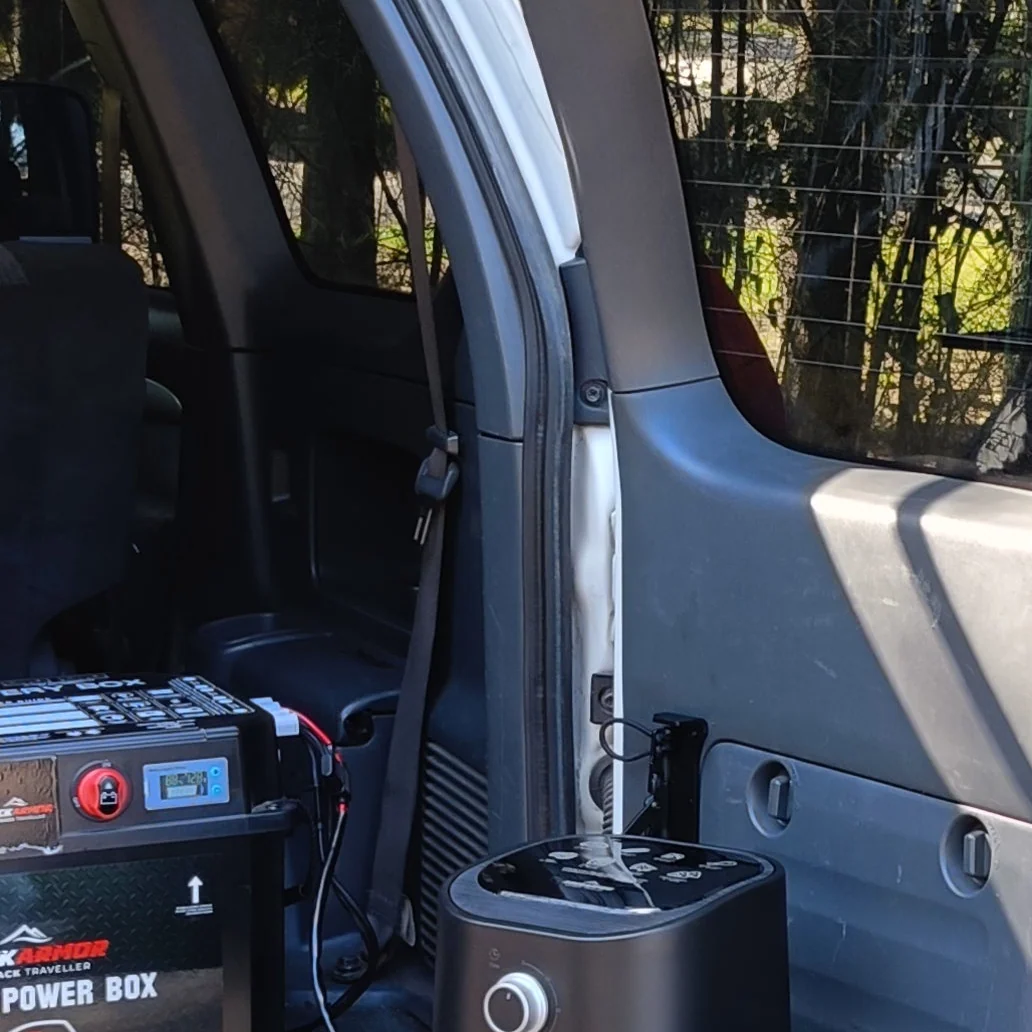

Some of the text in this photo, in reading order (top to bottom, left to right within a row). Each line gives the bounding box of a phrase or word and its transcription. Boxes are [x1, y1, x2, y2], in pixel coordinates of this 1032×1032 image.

[0, 939, 110, 967] KARMOR
[24, 961, 92, 977] TRAVELLER
[1, 971, 158, 1014] POWER BOX
